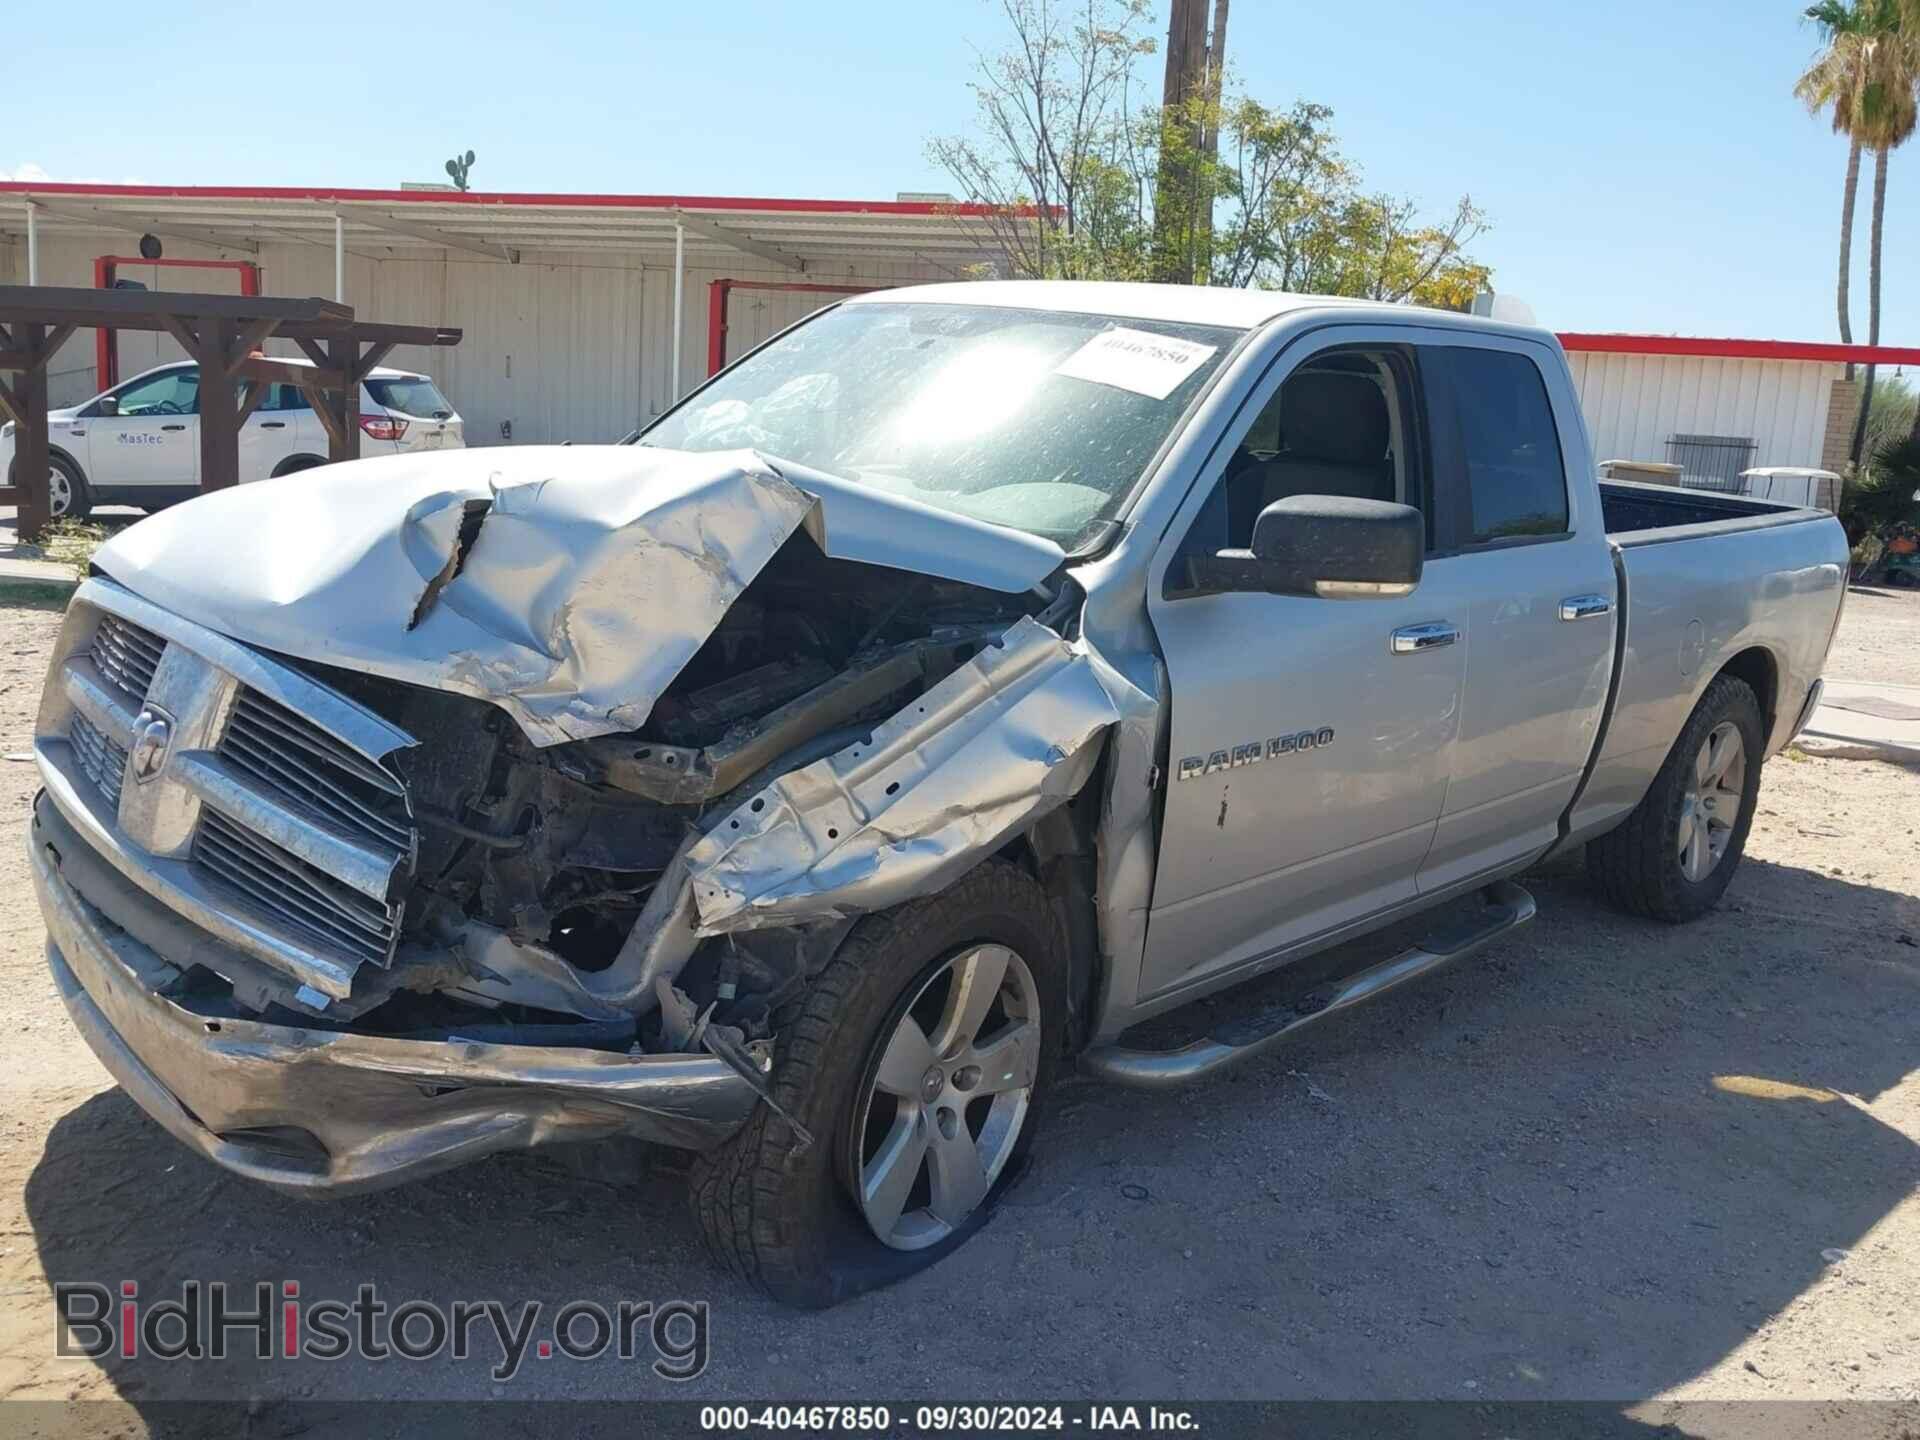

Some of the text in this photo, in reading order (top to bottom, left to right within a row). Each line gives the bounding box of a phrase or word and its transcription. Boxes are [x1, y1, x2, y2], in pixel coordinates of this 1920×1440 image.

[119, 432, 163, 444] MasTec
[1178, 726, 1335, 781] RAM 1500
